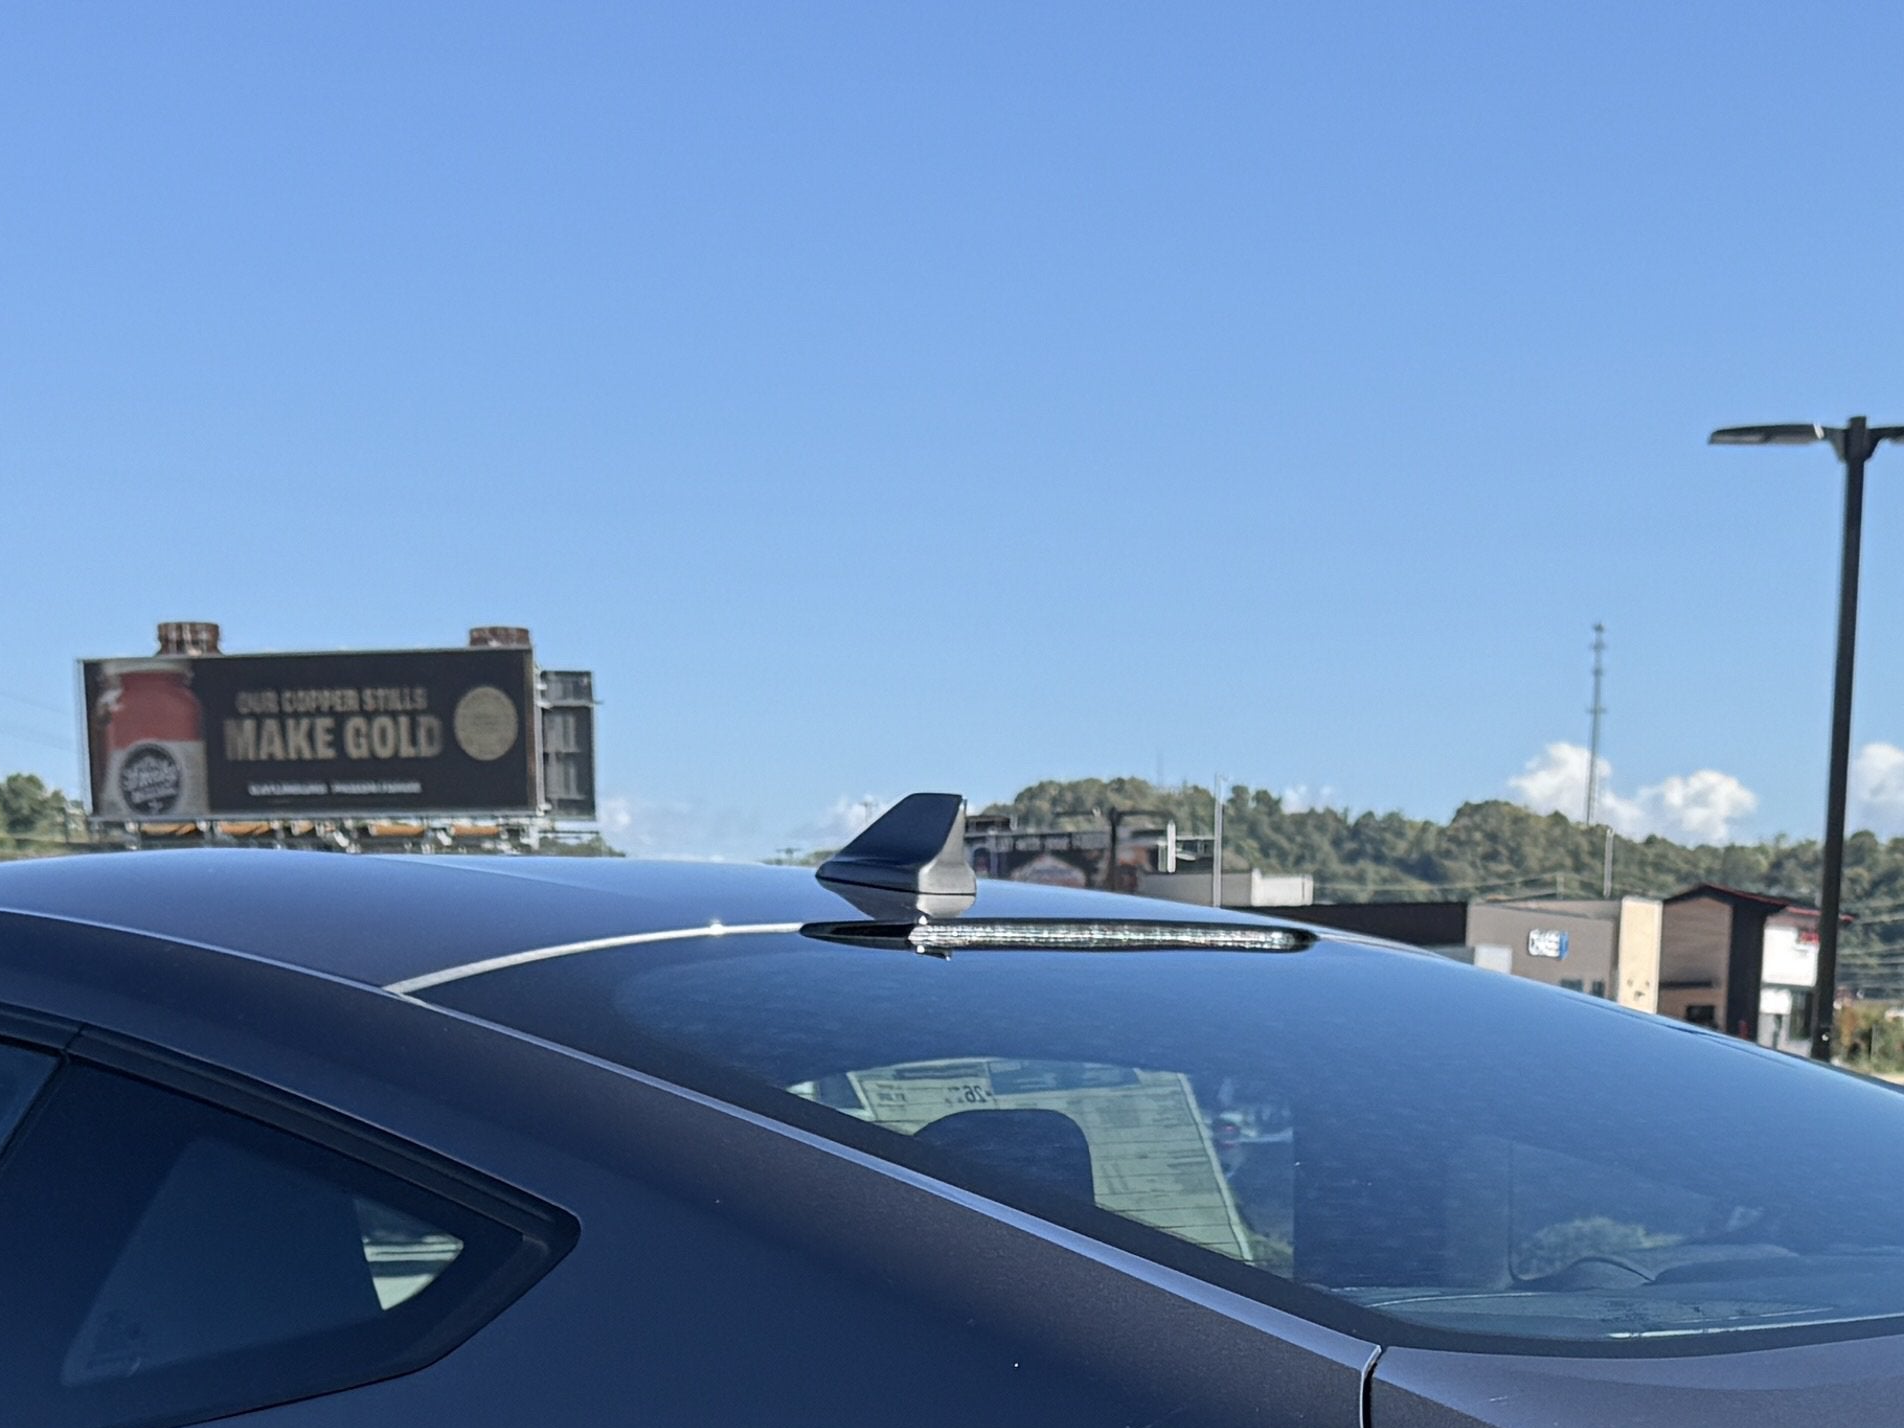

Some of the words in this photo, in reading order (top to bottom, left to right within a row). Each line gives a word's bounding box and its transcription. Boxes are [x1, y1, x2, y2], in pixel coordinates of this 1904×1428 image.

[363, 687, 427, 711] STILLS
[224, 718, 336, 761] MAKE
[344, 715, 442, 760] GOLD
